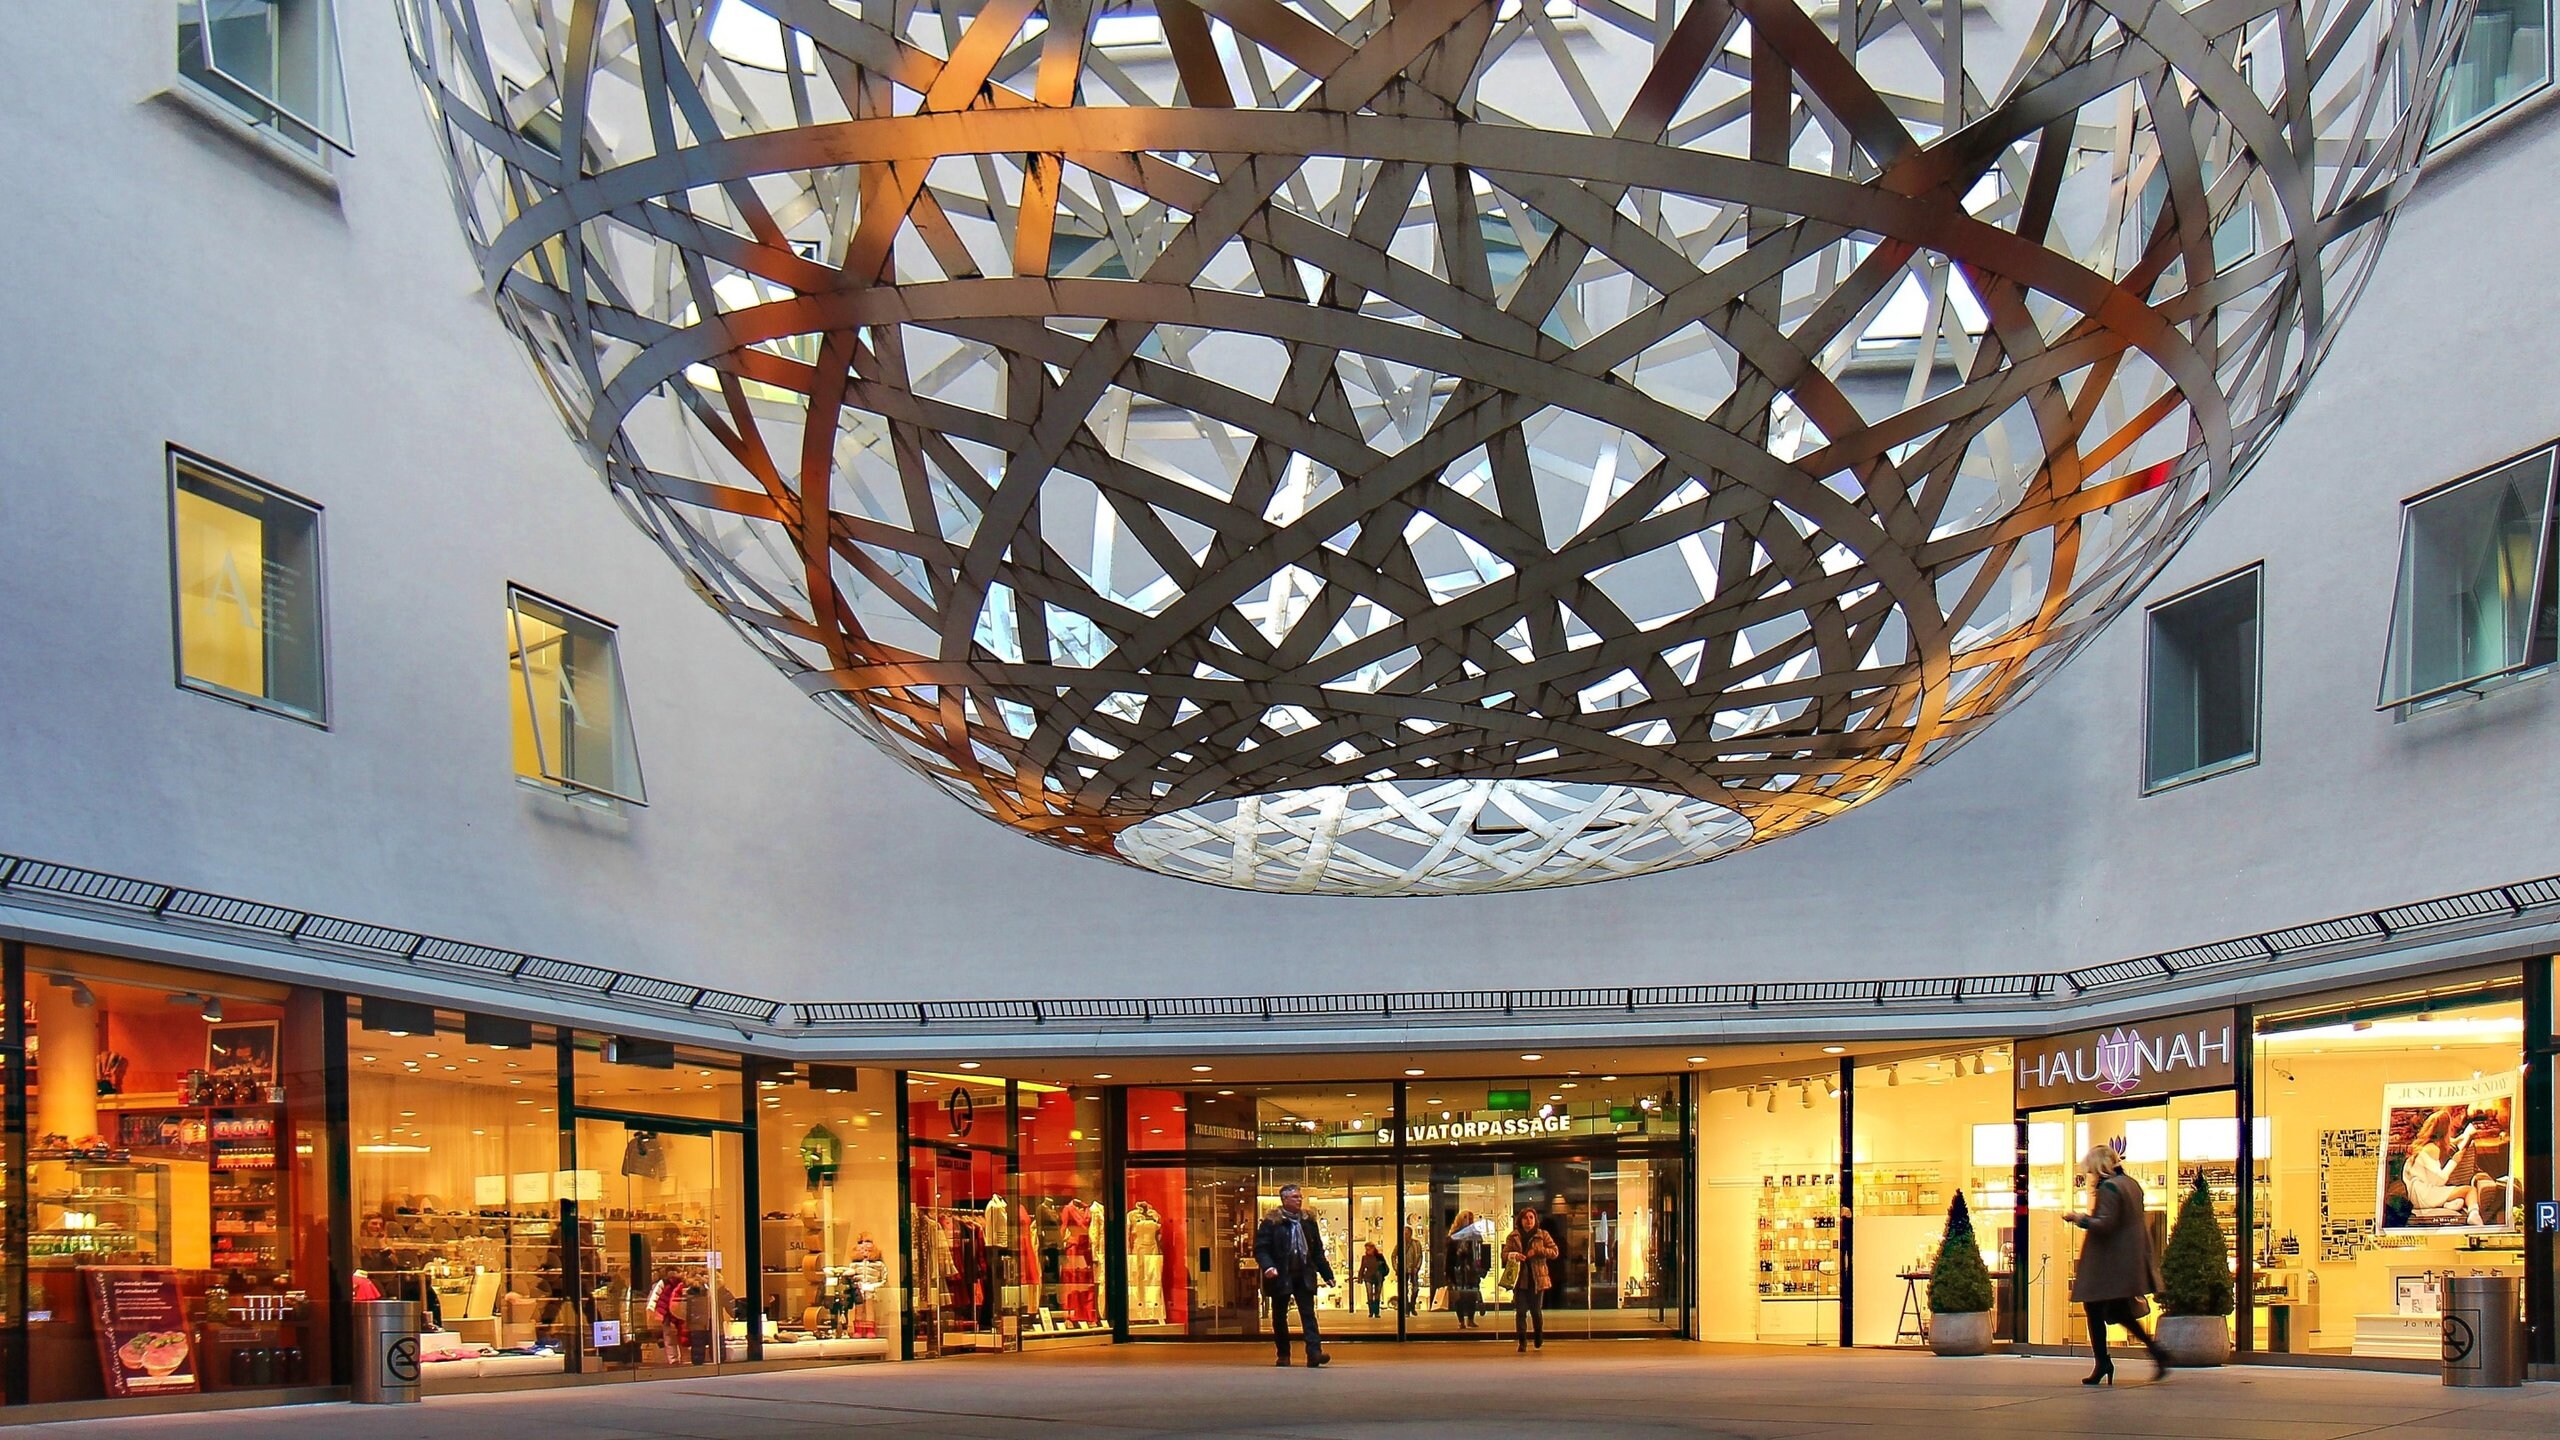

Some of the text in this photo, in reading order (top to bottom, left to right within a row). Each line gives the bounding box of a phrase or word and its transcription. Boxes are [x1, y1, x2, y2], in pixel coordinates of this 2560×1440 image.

[2020, 1026, 2230, 1090] HAUTNAH
[2399, 1078, 2507, 1098] JUST LIKE SUNDAY
[1377, 1115, 1571, 1144] SLVATORPASSAGE
